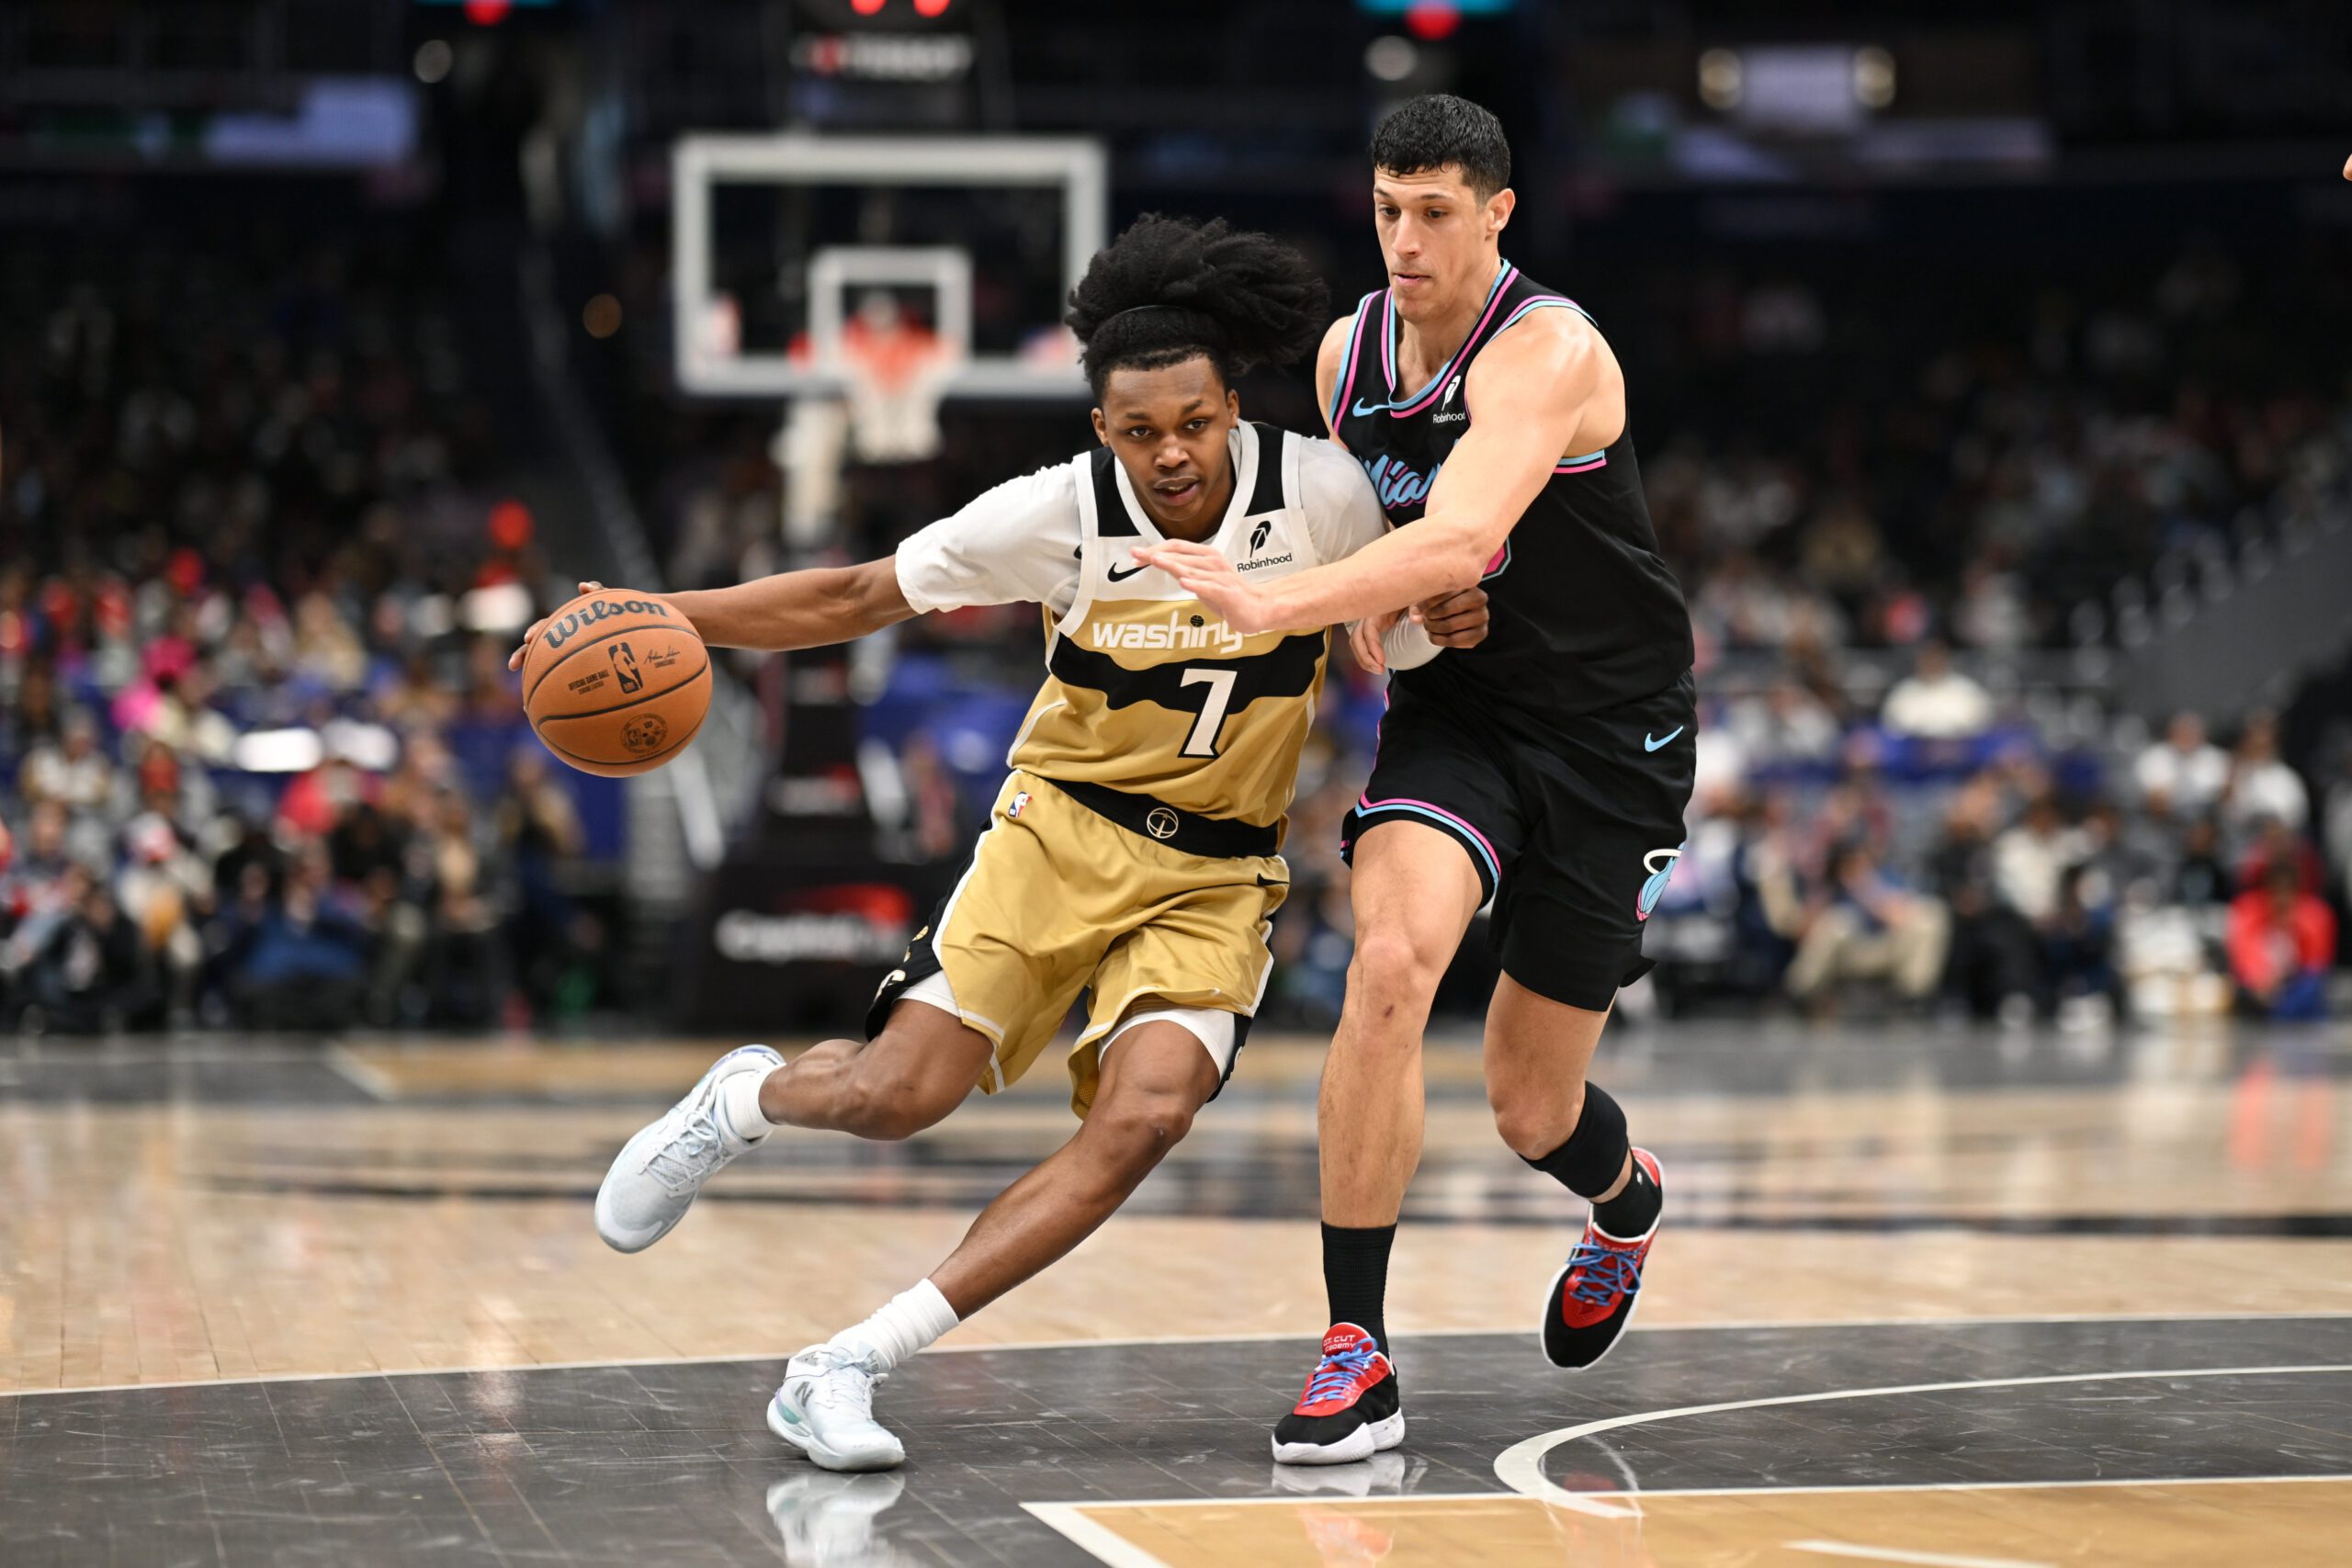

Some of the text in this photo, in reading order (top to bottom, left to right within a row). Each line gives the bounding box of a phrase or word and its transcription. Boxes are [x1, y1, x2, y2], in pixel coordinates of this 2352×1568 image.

[1359, 454, 1442, 510] Mia
[1237, 553, 1293, 573] Robinhood
[543, 600, 668, 649] Wilson
[1092, 610, 1275, 655] washing
[1177, 668, 1238, 759] 7
[1334, 1335, 1355, 1343] CUT
